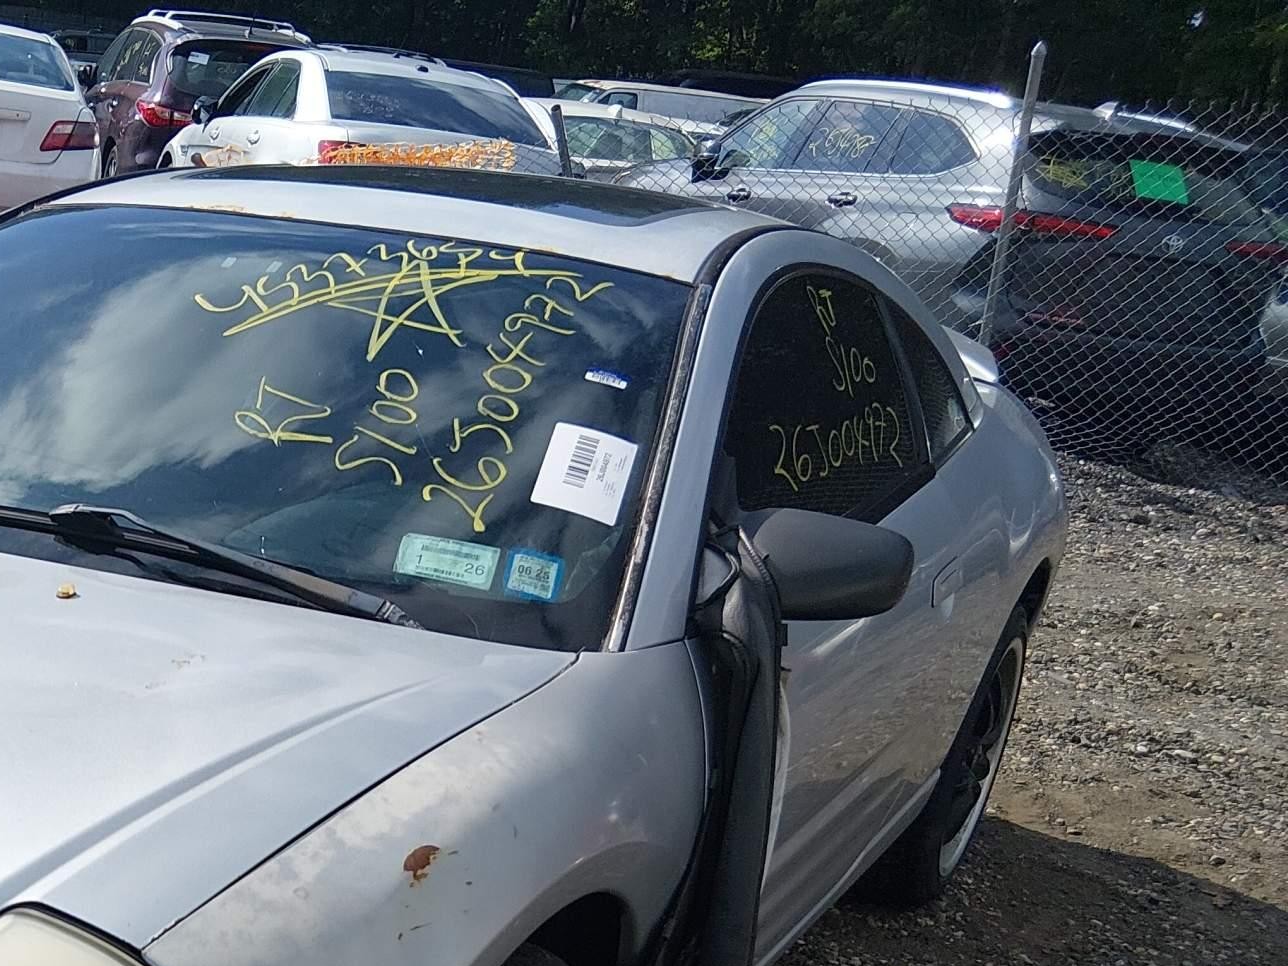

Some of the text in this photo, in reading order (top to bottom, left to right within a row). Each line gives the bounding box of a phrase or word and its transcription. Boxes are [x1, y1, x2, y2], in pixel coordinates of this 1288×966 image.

[194, 239, 529, 313] 45373654
[415, 554, 423, 565] 1
[464, 562, 486, 577] 26
[517, 564, 532, 576] 06
